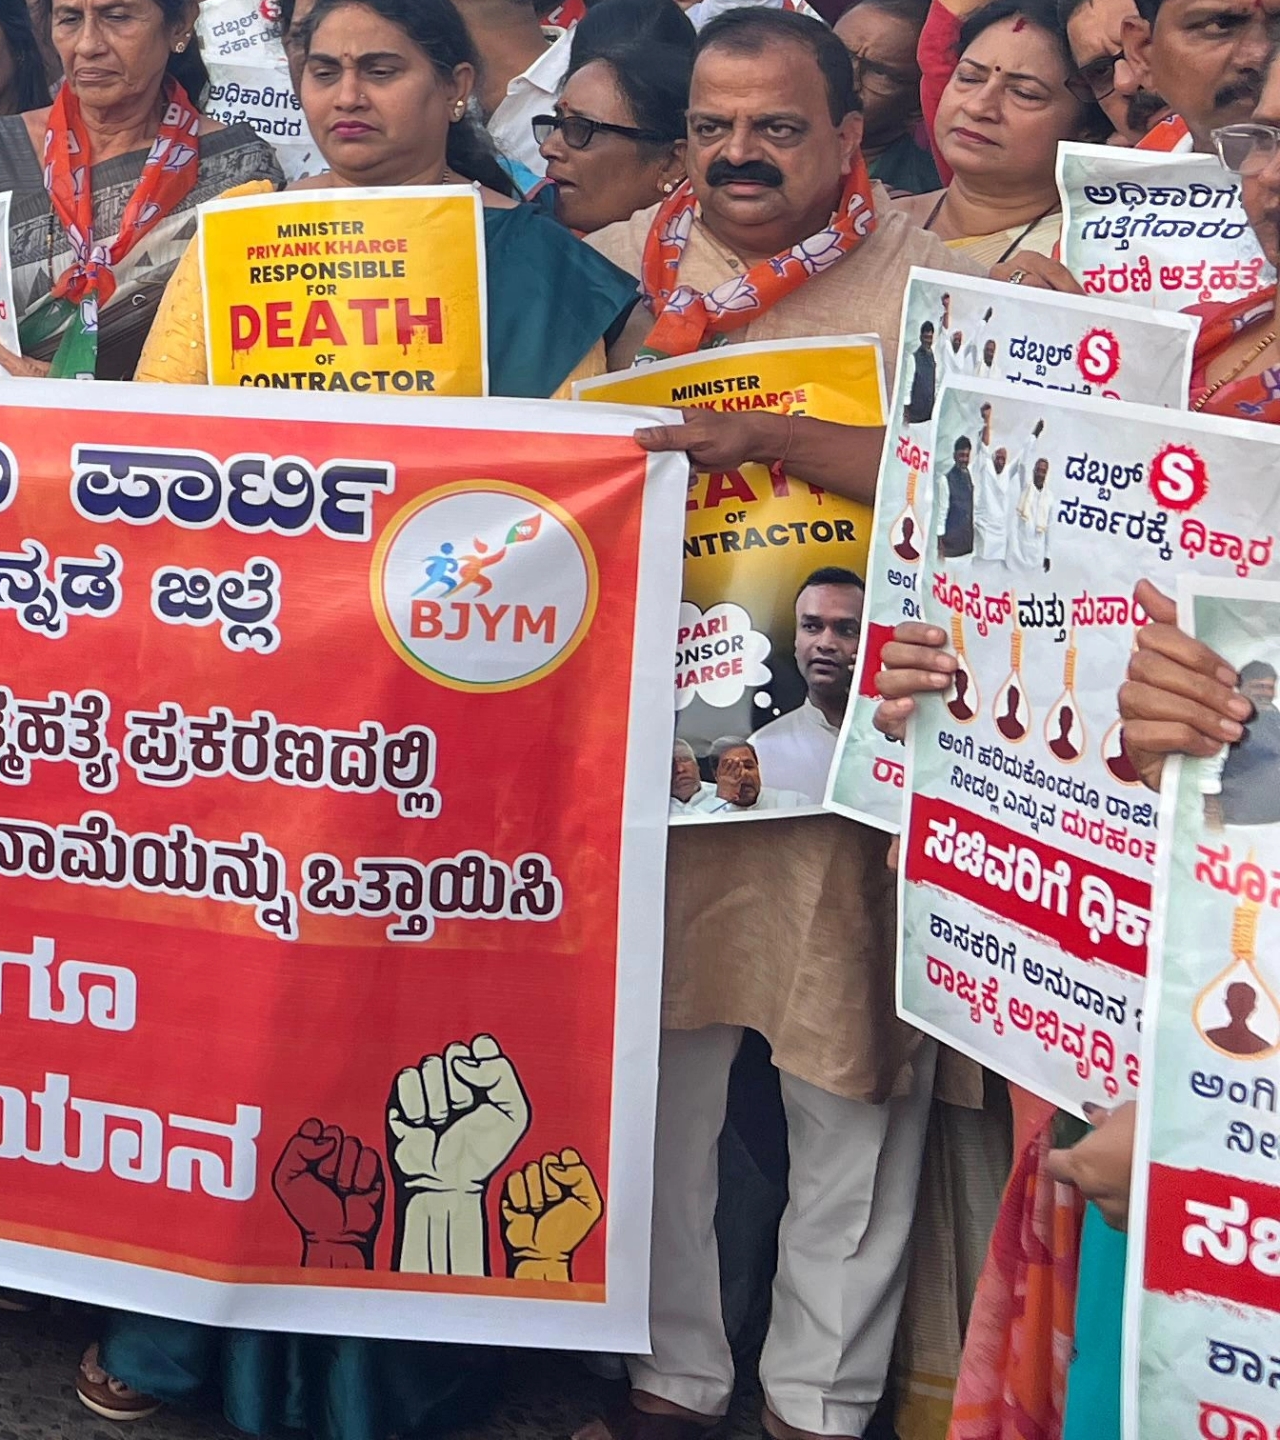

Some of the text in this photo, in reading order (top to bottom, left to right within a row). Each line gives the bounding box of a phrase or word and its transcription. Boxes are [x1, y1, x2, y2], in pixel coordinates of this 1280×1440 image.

[247, 239, 408, 260] PRIYANK KHARGE
[278, 221, 364, 239] MINISTER
[250, 260, 405, 284] RESPONSIBLE
[306, 284, 337, 296] FOR
[1083, 255, 1151, 294] ಸರಣಿ
[230, 298, 443, 356] DEATH
[240, 371, 435, 391] CONTRACTOR
[315, 354, 335, 366] OF
[1010, 336, 1072, 375] ಡಬ್ಬಲ್
[73, 443, 393, 539] ಪಾರ್ಟಿ
[1065, 450, 1195, 502] ಡಬ್ಬಲ್ S
[1058, 497, 1272, 577] ಸರ್ಕಾರಕ್ಕೆ ಧಿಕ್ಕಾರ
[152, 555, 281, 652] ಜಿಲ್ಲೆ
[410, 598, 557, 645] BJYM
[932, 572, 1067, 641] ಸೂಸೈಡ್ ಮತ್ತು
[126, 703, 440, 817] ಪ್ರಕರಣದಲ್ಲಿ
[938, 730, 974, 762] ಅಂಗಿ
[924, 817, 1073, 916] ಸಚಿವರಿಗೆ
[303, 849, 562, 940] ಒತ್ತಾಯಿಸಿ
[930, 912, 1126, 1024] ಶಾಸಕರಿಗೆ ಅನುದಾನ
[927, 954, 1005, 1037] ರಾಜ್ಯಕ್ಕೆ
